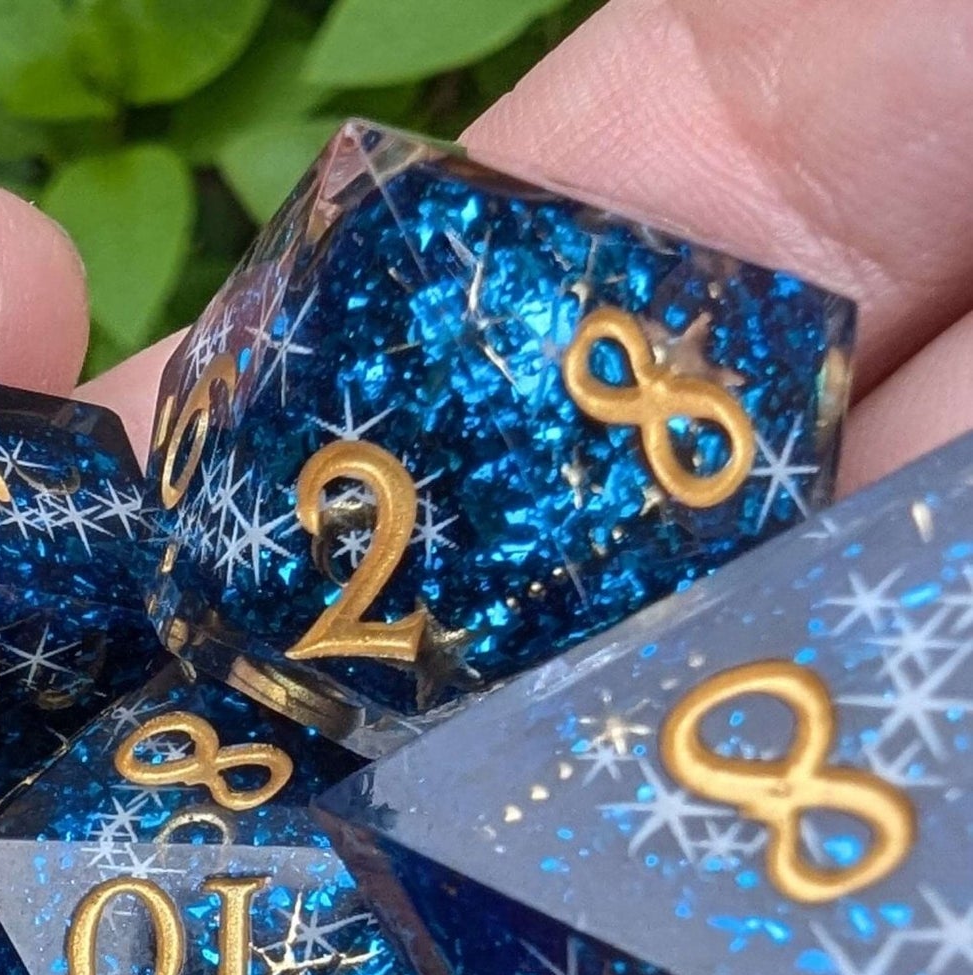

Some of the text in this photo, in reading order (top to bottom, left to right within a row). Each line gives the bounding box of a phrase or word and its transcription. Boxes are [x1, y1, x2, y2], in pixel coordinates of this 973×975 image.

[563, 306, 755, 509] 8
[284, 439, 427, 664] 2
[115, 710, 294, 811] 8
[657, 657, 918, 905] 8
